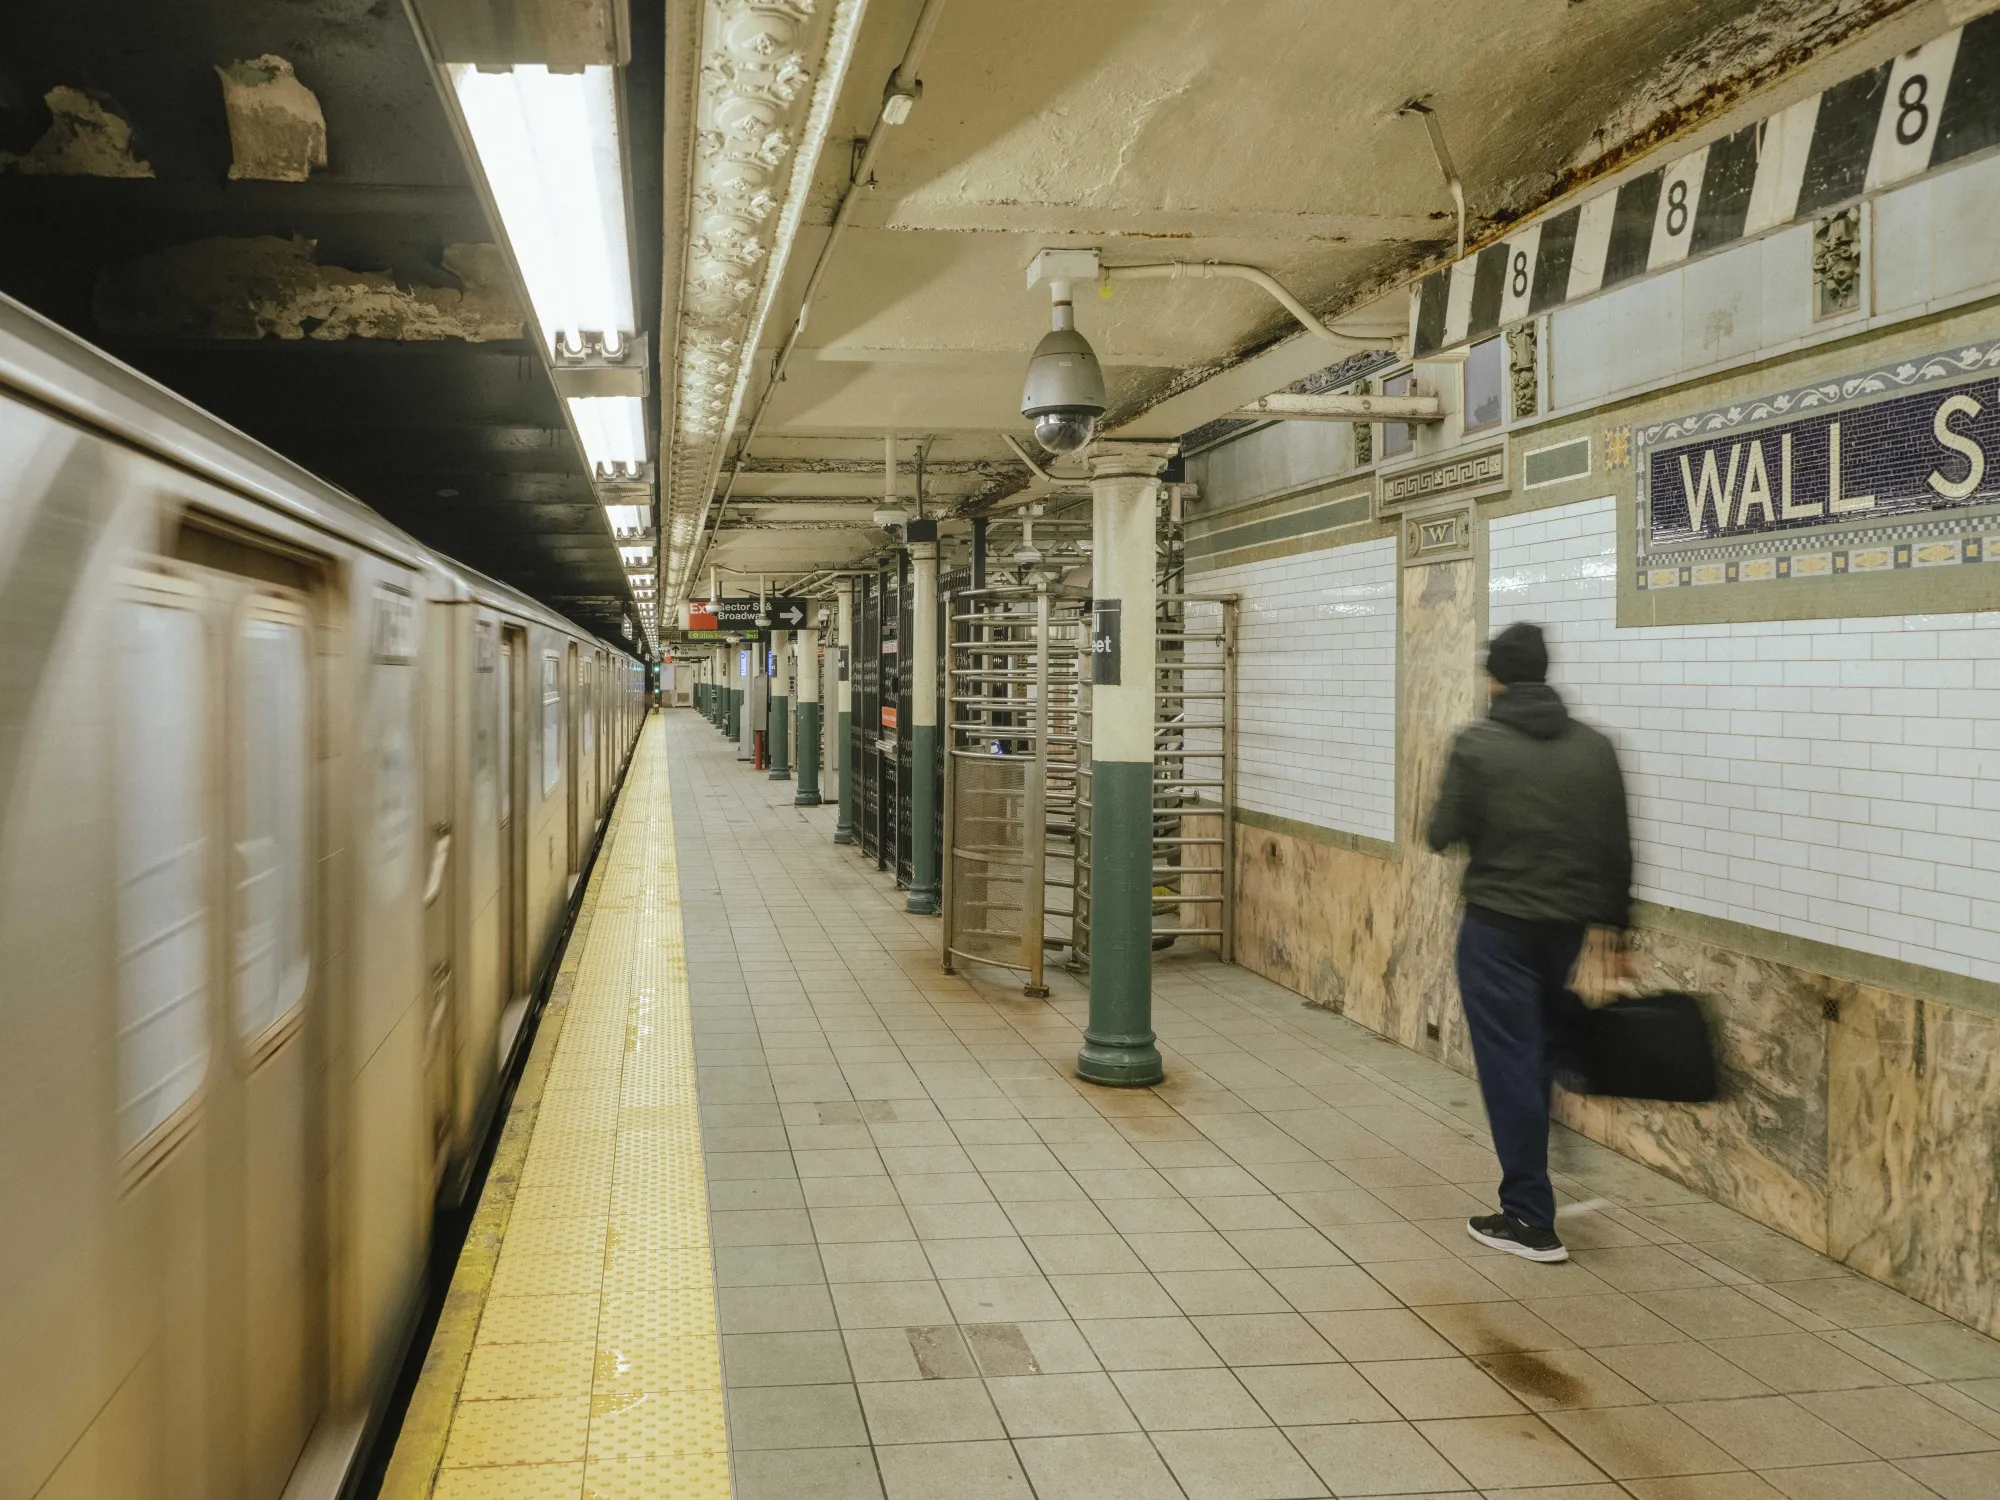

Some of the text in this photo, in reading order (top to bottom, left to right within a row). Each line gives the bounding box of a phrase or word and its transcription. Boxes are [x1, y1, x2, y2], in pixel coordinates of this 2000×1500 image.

[1896, 74, 1928, 146] 8
[1666, 179, 1688, 237] 8
[1512, 250, 1528, 298] 8
[1679, 389, 2000, 533] WALL S
[1428, 524, 1449, 543] W
[690, 603, 709, 614] Ex
[718, 611, 761, 620] Broadwa
[765, 602, 773, 611] &
